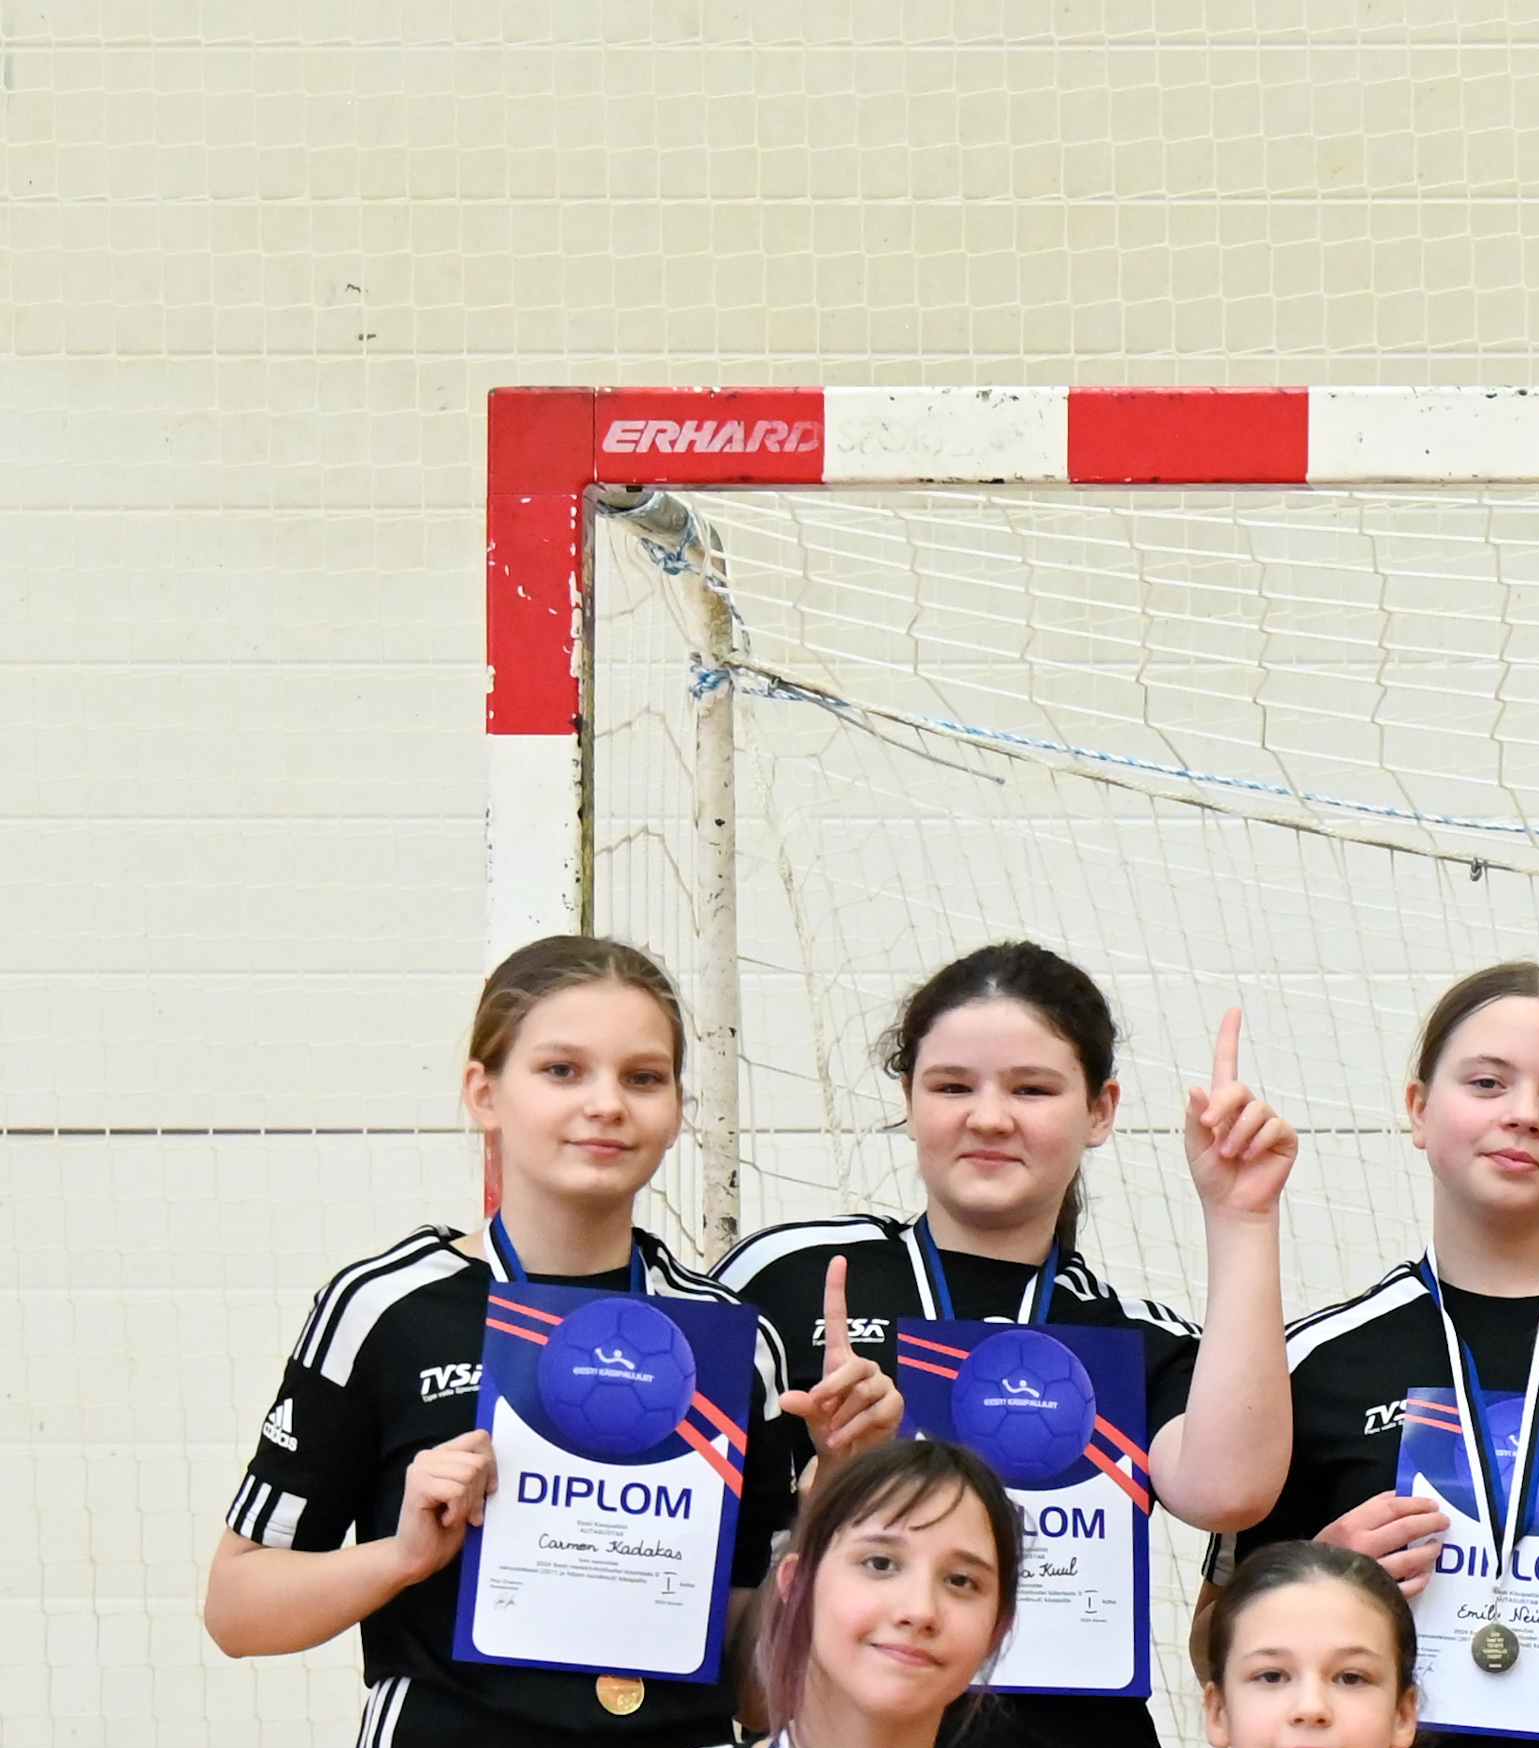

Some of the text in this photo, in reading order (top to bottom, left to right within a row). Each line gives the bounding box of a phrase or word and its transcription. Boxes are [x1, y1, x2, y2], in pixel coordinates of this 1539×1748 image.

[602, 420, 823, 453] ERHARD
[812, 1318, 890, 1340] TSK
[518, 1471, 692, 1520] DIPLOM
[1016, 1505, 1105, 1540] LOM
[538, 1533, 683, 1560] Carmen Kadakas
